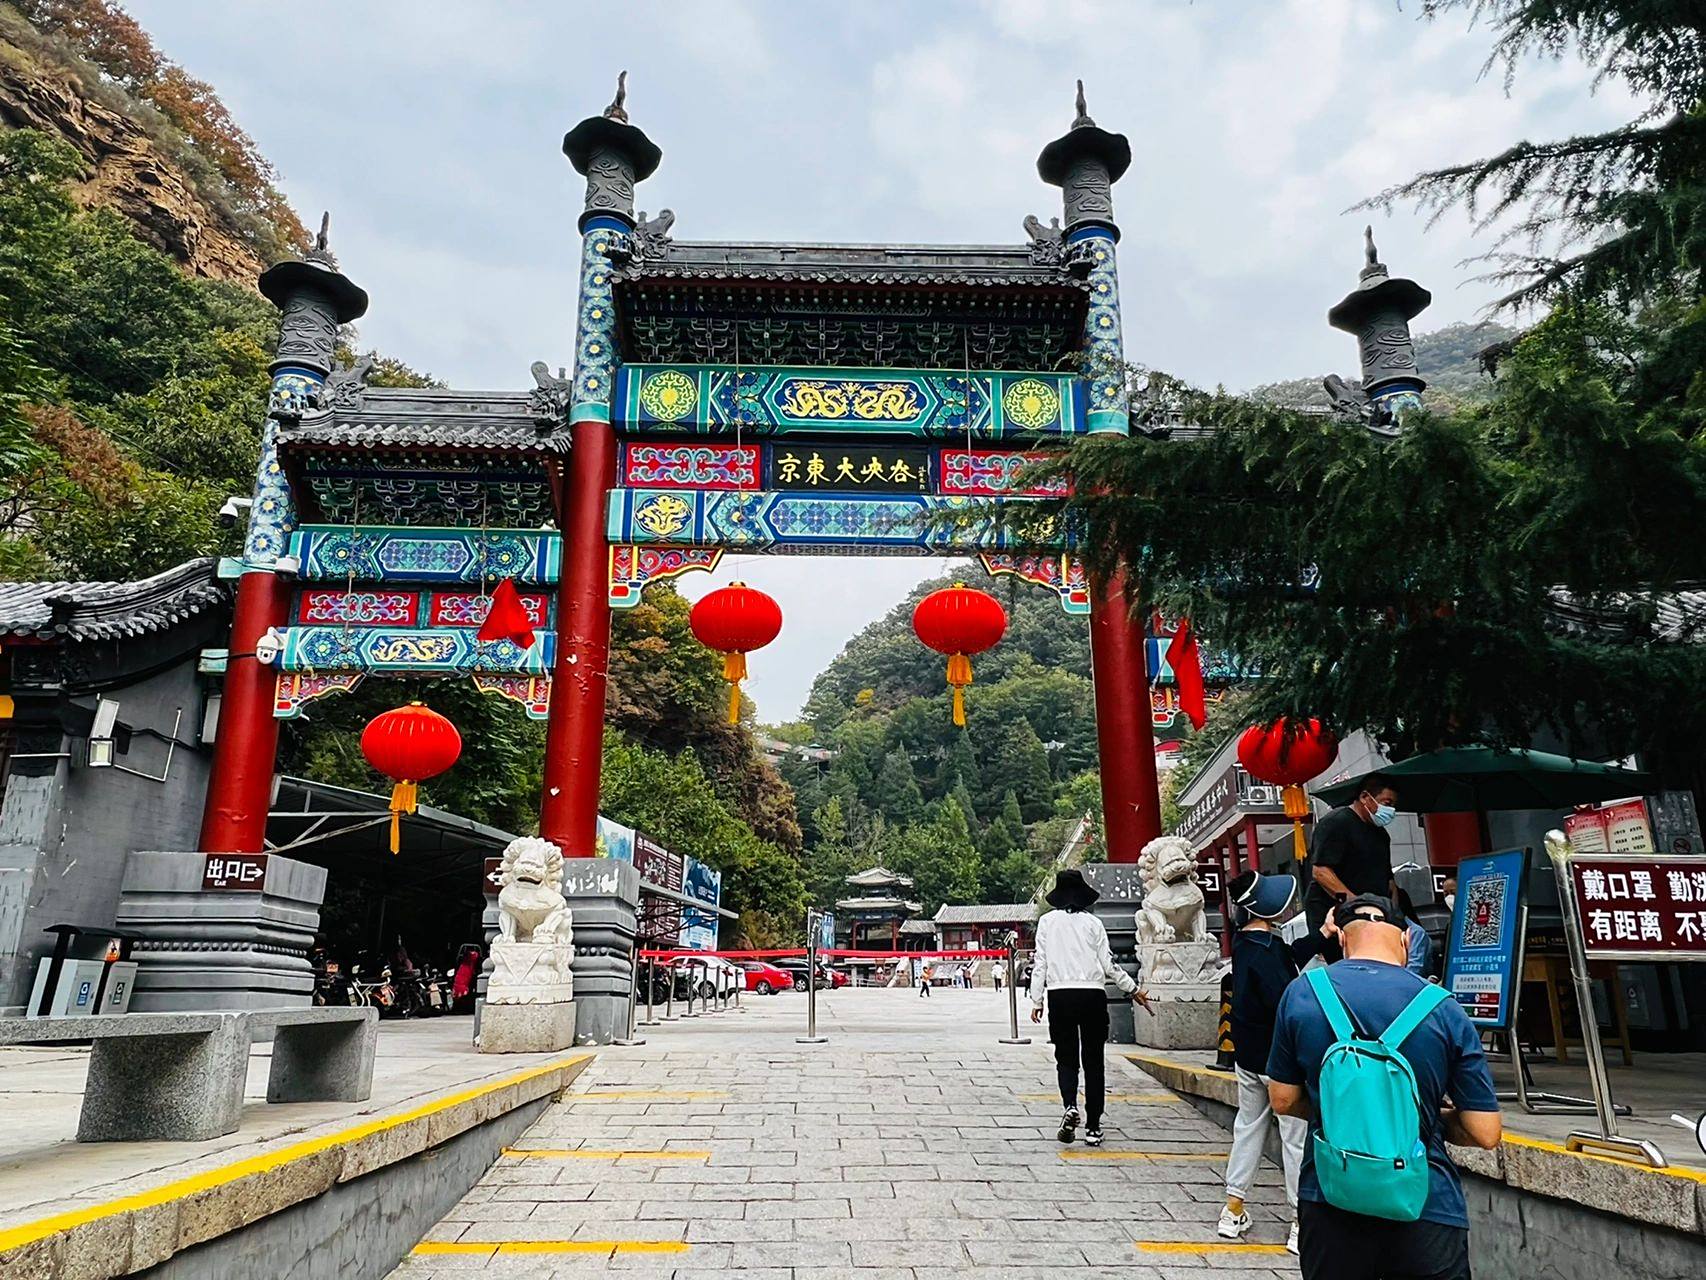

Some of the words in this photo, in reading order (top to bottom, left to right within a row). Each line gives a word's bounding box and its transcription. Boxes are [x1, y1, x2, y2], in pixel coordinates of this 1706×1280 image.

[206, 858, 241, 879] 出口
[1582, 869, 1657, 902] 戴口罩
[1588, 908, 1662, 942] 有距离
